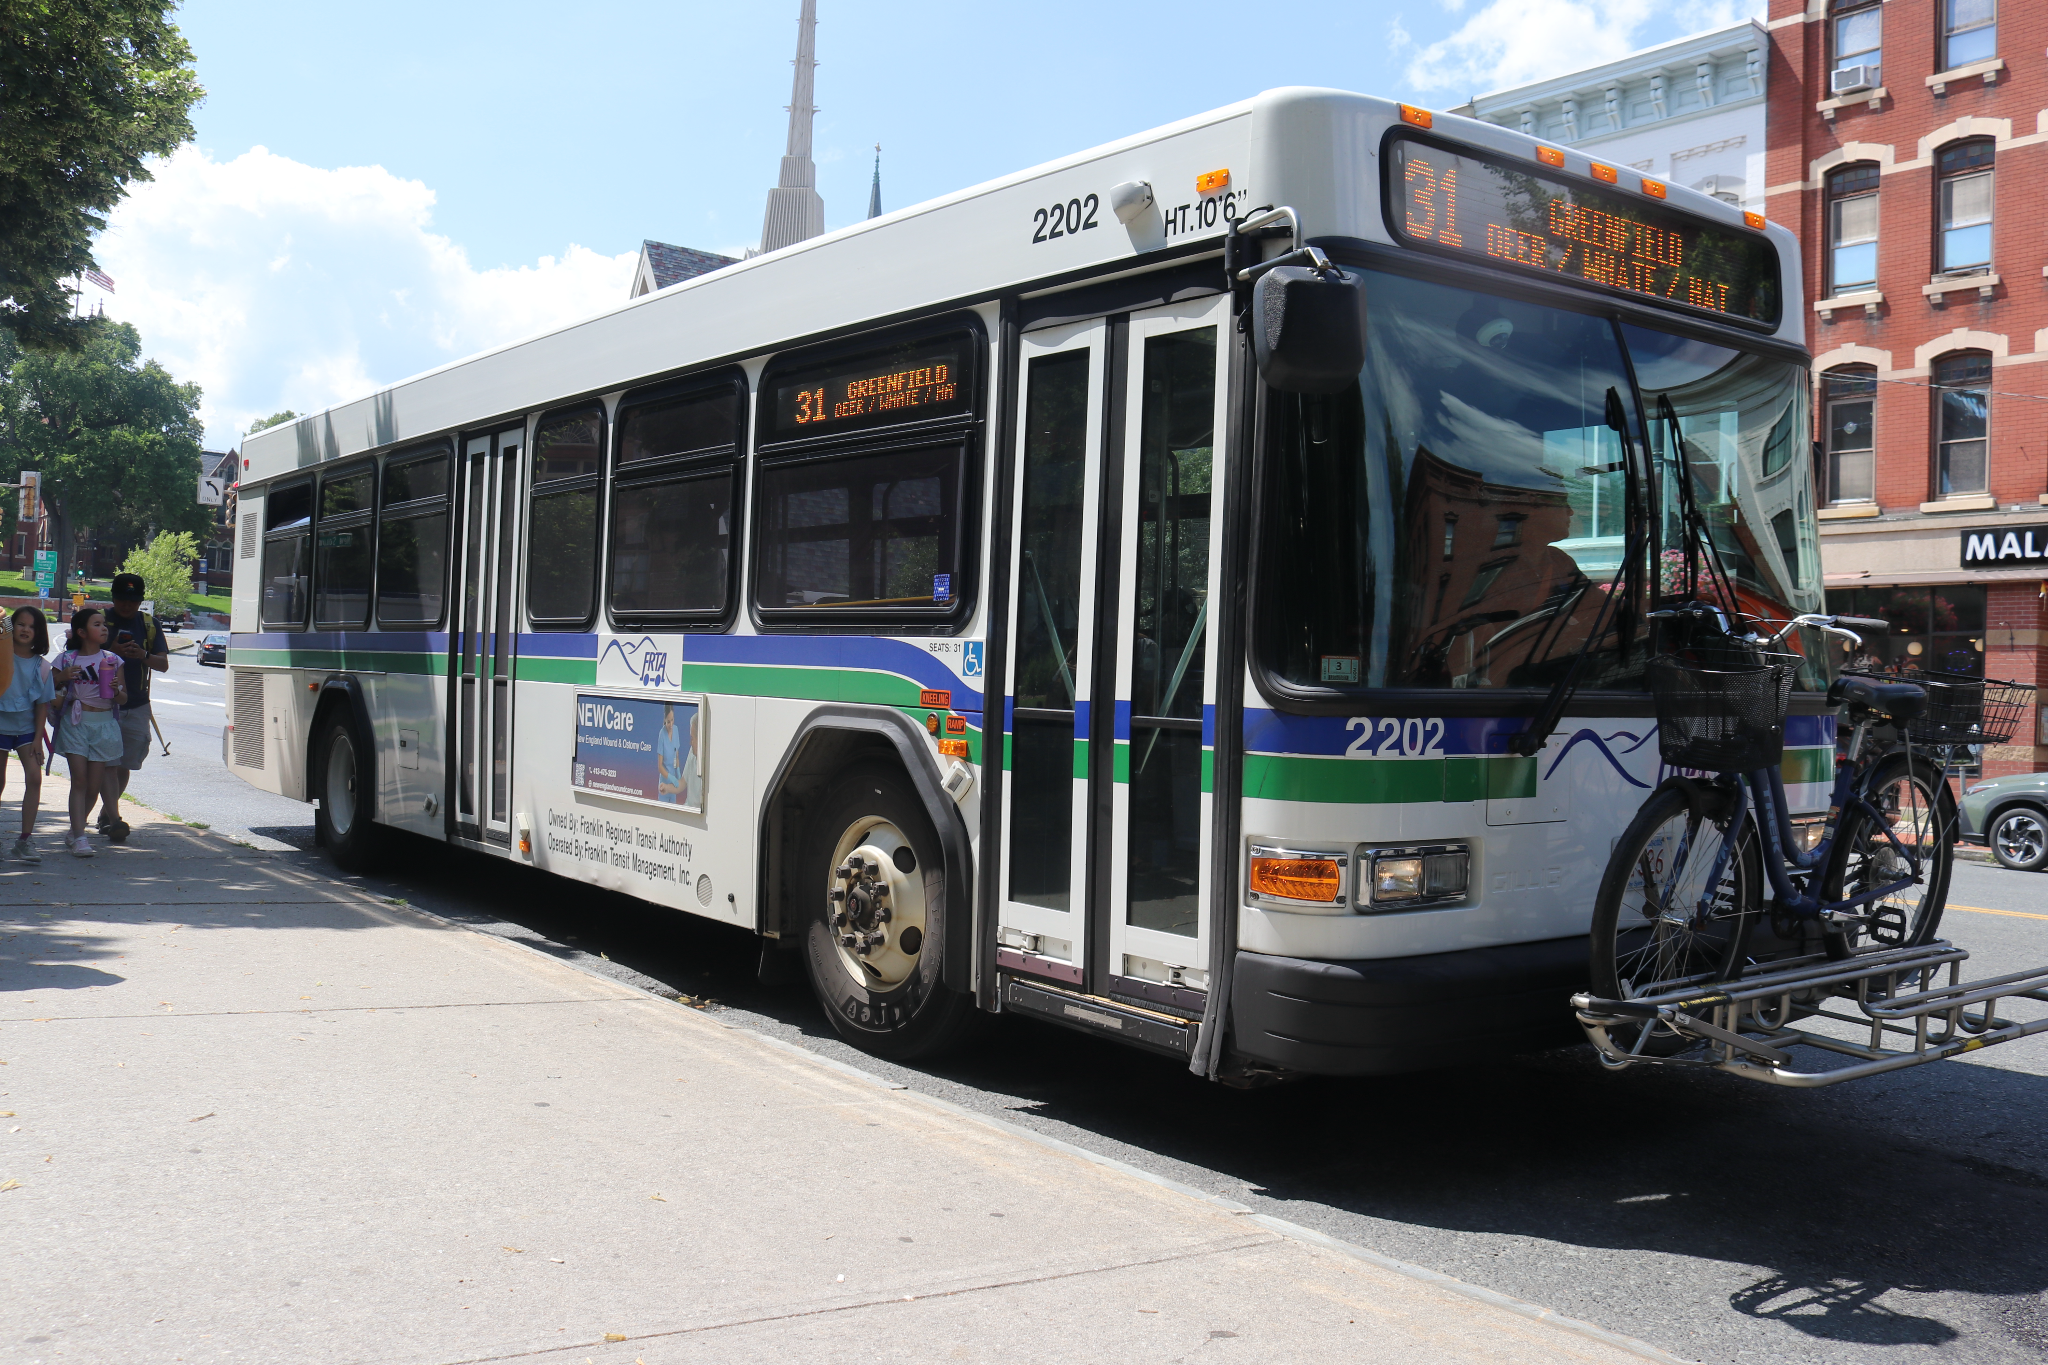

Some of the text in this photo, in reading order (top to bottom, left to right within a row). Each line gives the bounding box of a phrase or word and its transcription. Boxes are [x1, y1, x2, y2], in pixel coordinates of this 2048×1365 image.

[1032, 193, 1099, 244] 2202
[1404, 158, 1463, 248] 31
[1549, 198, 1683, 268] GREENFIELD
[1486, 222, 1547, 269] DEER
[1582, 249, 1657, 296] WHATE
[847, 364, 949, 399] GREENFIELD
[795, 387, 827, 424] 31
[834, 398, 865, 418] DEER
[879, 389, 920, 411] WHATE
[1964, 530, 2048, 561] MAL
[928, 642, 961, 653] SEATS: 31
[640, 651, 667, 684] FRTA
[1335, 661, 1343, 671] 3
[922, 692, 949, 705] KNEELING
[577, 702, 634, 732] NEWCare
[947, 717, 964, 731] RAMP
[585, 734, 603, 747] England
[602, 735, 618, 748] Wound
[617, 738, 622, 748] &
[622, 740, 640, 752] Ostomy
[640, 741, 652, 752] Care
[1344, 716, 1445, 757] 2202
[548, 808, 693, 862] Owned By: Franklin Regional Transit Authority
[1762, 783, 1780, 854] TREK
[547, 832, 692, 886] Operated By: Franklin Transit Management, Inc.
[1491, 866, 1562, 894] GILLIG
